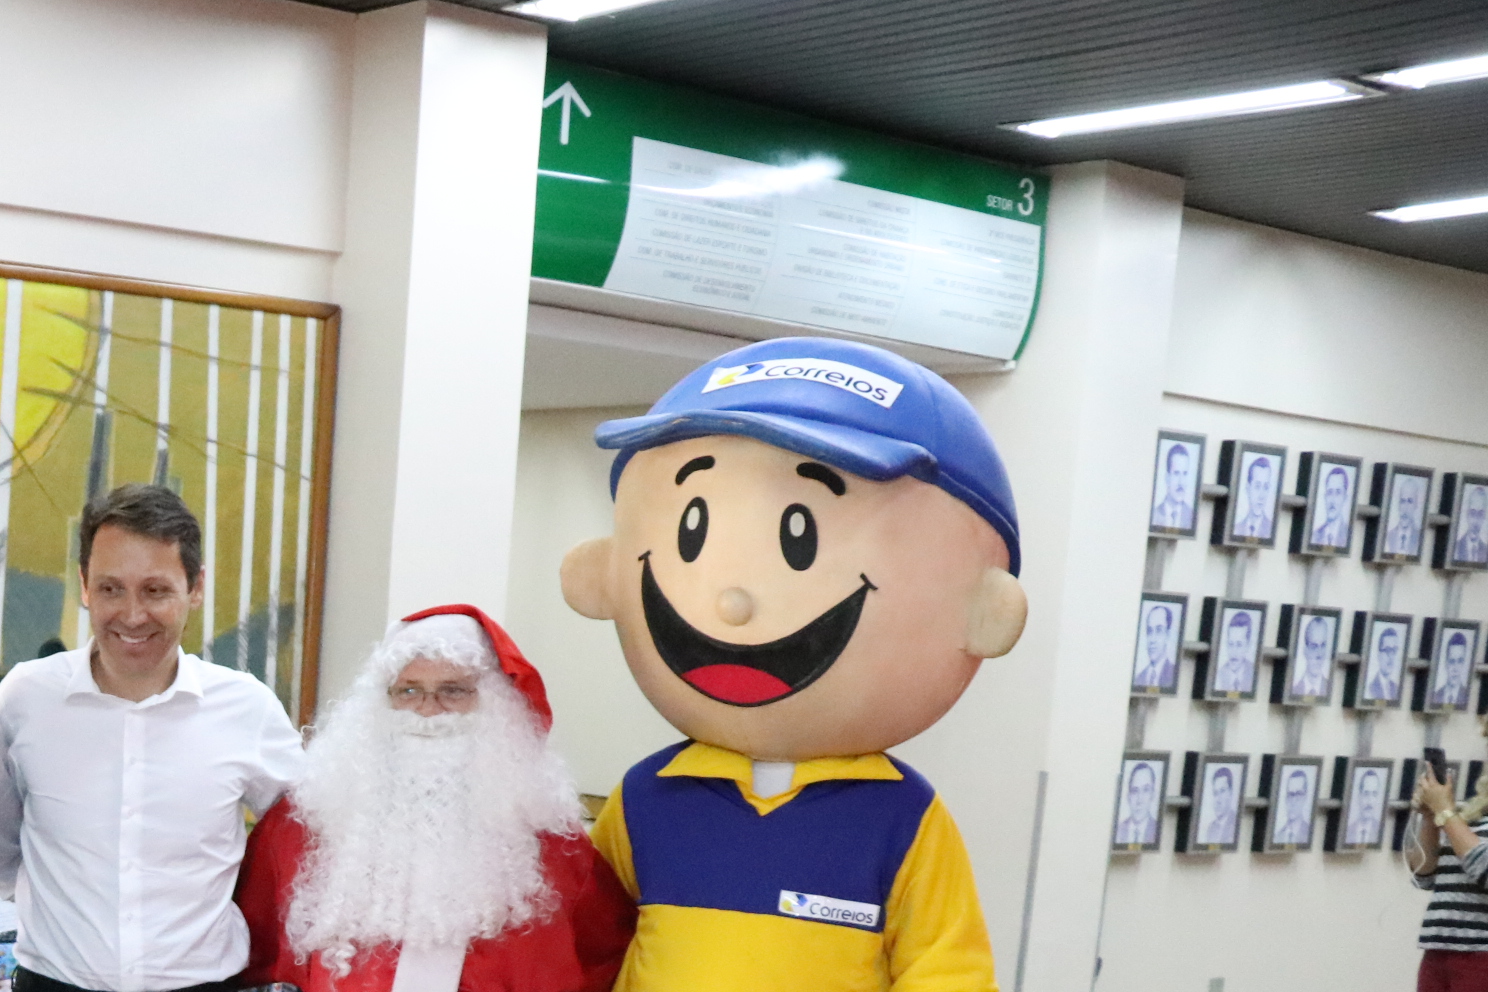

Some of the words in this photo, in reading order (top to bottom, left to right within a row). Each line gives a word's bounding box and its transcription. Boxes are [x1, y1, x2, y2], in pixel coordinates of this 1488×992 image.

[985, 194, 1014, 212] SETOR
[1017, 177, 1035, 216] 3
[764, 363, 889, 402] Correios
[809, 902, 874, 924] Correios
